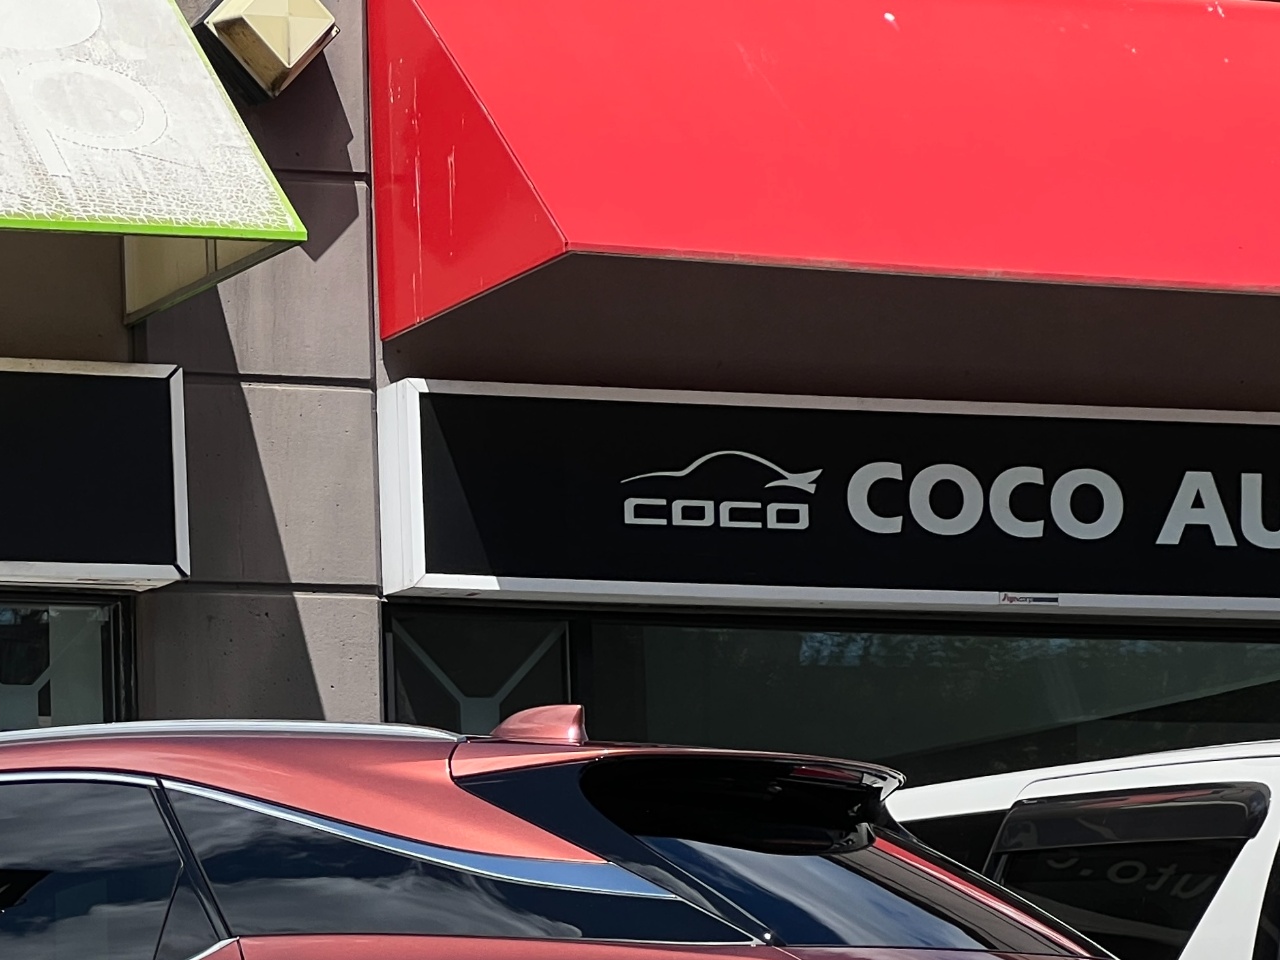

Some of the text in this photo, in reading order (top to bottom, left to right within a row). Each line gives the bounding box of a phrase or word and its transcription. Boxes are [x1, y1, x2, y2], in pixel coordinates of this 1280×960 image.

[623, 497, 810, 530] COCO
[846, 460, 1280, 549] COCO AU
